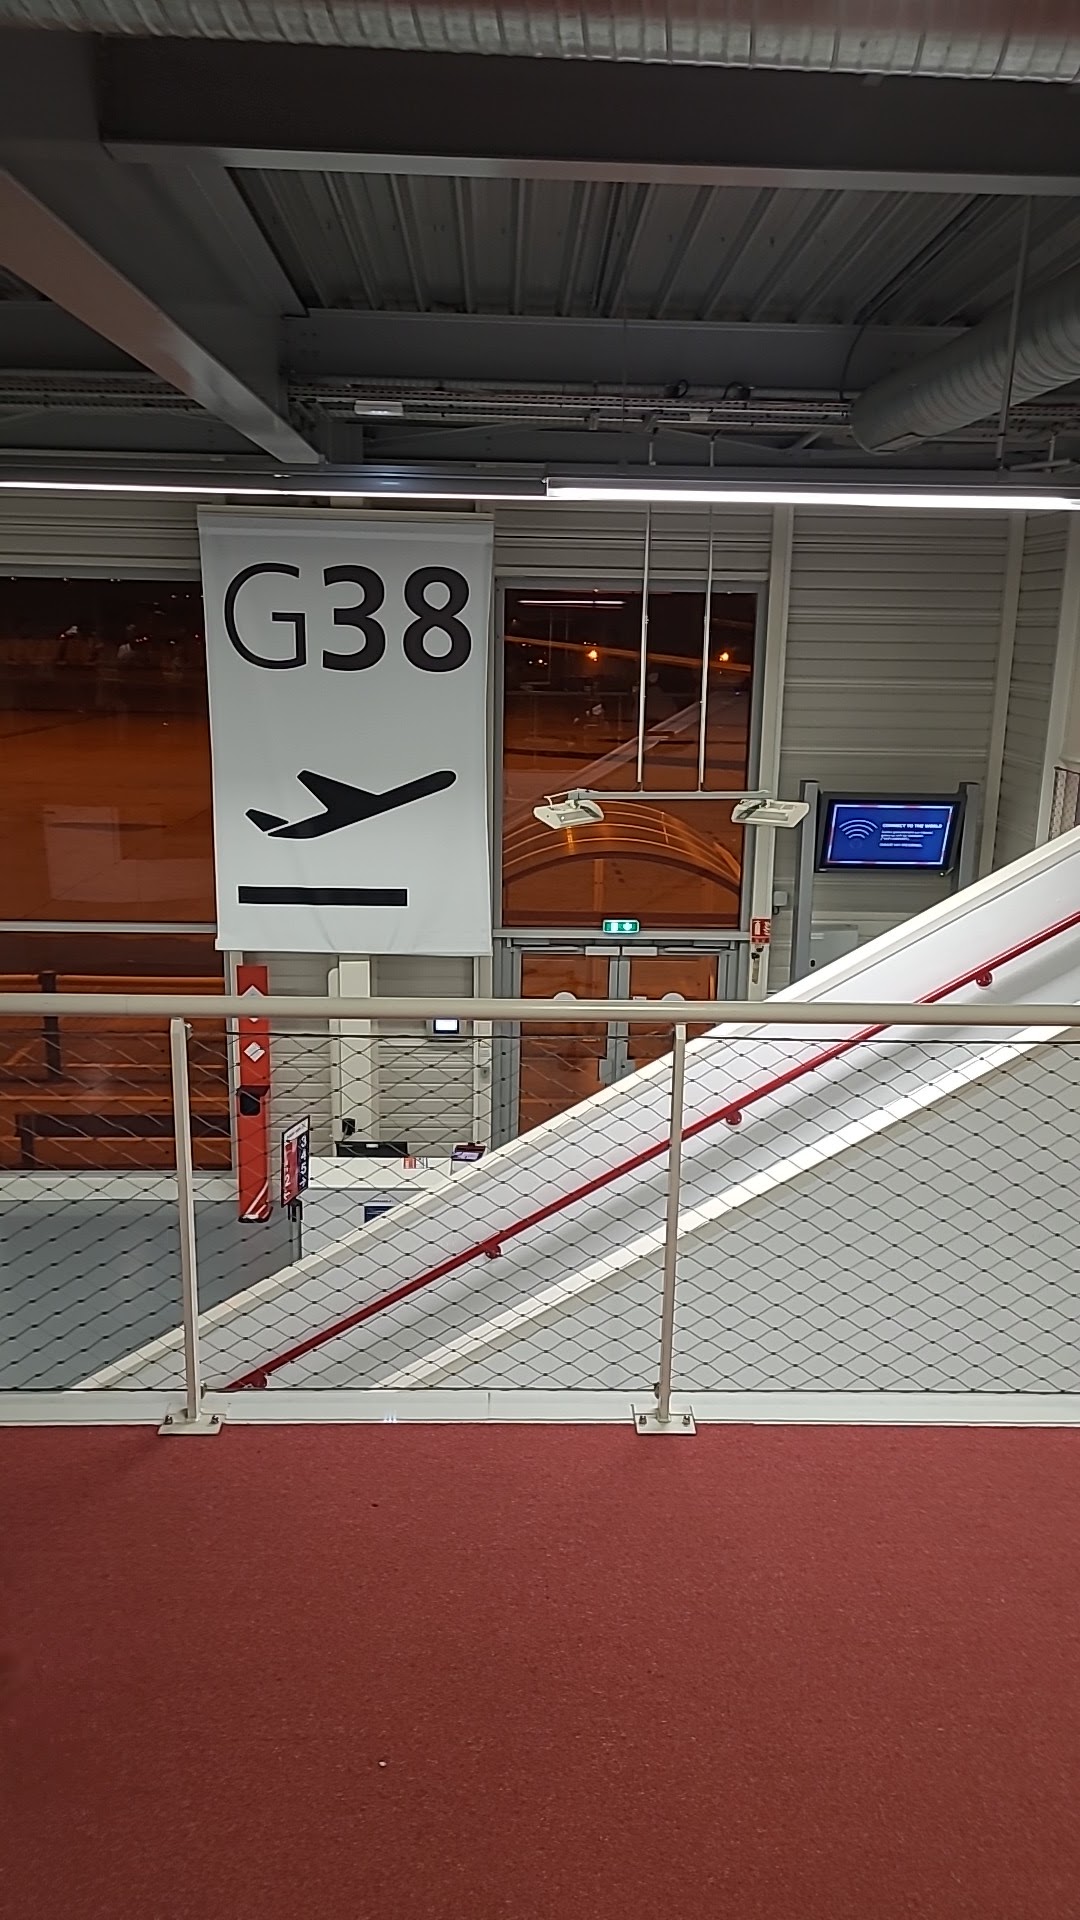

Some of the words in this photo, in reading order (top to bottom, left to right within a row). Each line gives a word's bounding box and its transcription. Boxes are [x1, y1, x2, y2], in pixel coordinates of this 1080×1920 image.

[224, 562, 472, 672] G38
[300, 1134, 307, 1148] 3
[300, 1148, 307, 1161] 4
[300, 1162, 307, 1175] 5
[284, 1173, 291, 1188] 2
